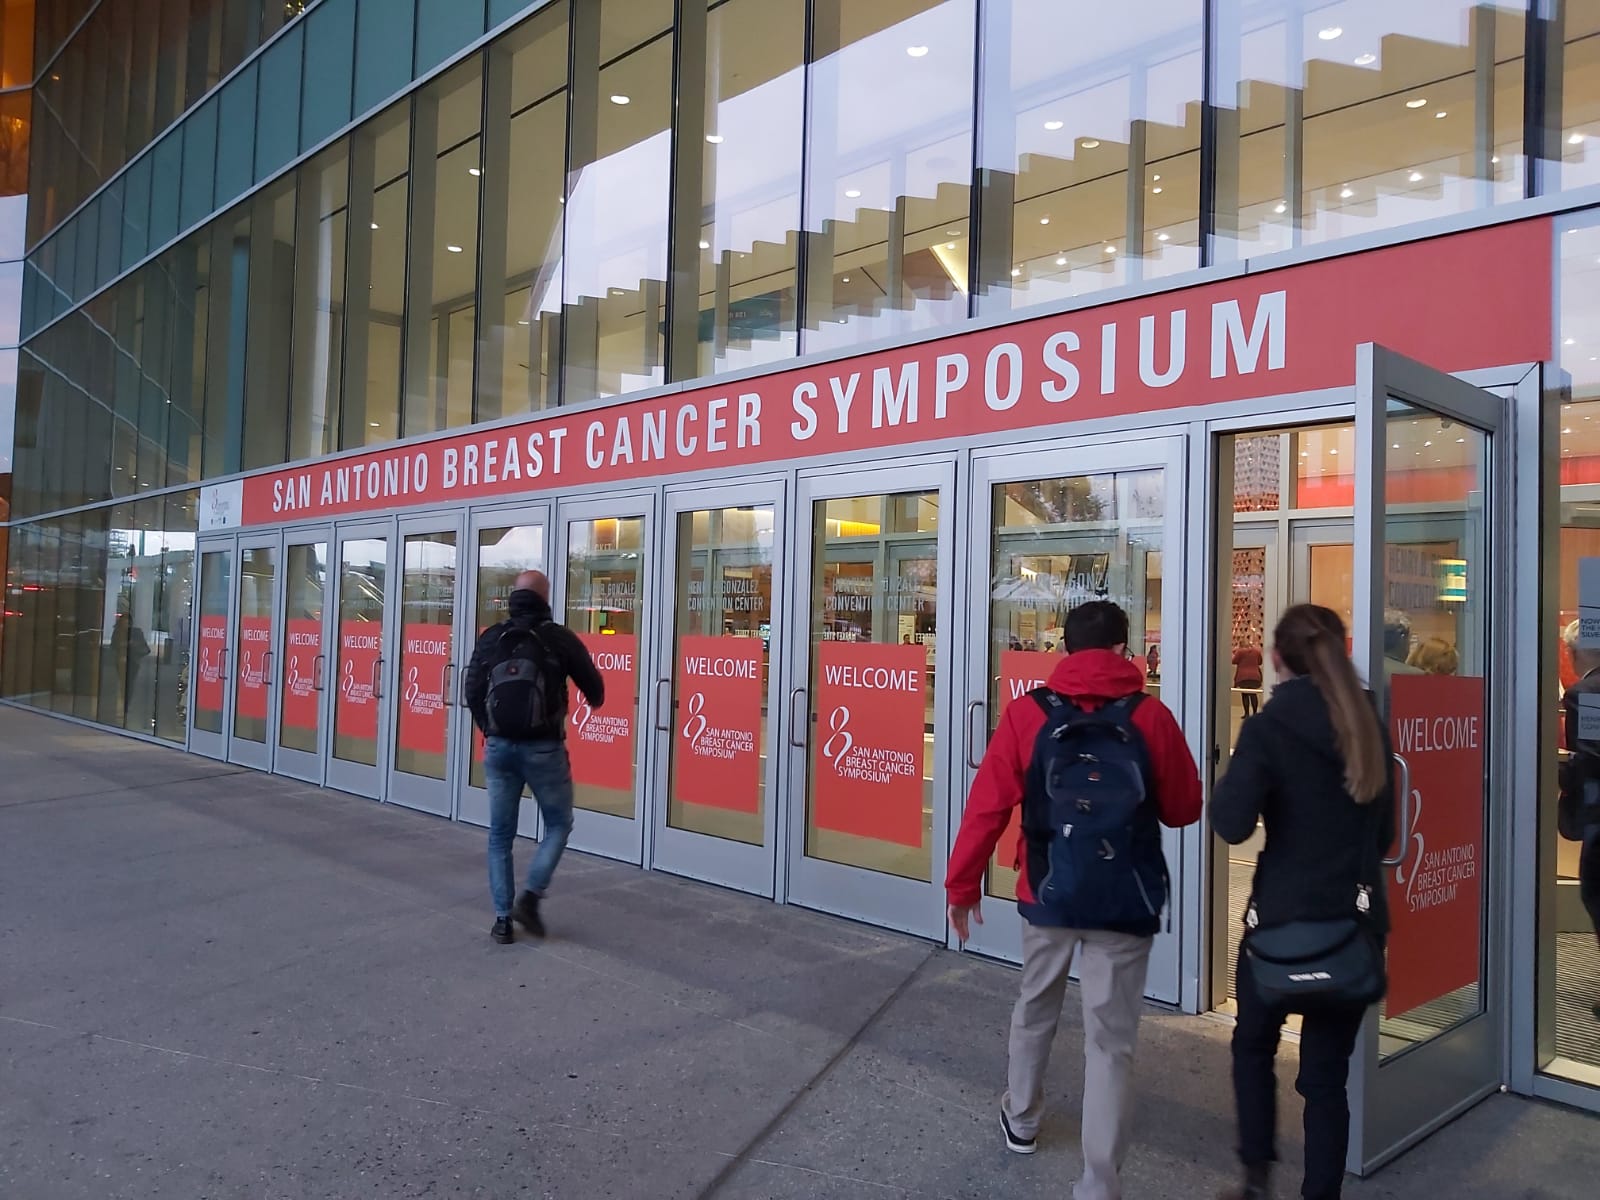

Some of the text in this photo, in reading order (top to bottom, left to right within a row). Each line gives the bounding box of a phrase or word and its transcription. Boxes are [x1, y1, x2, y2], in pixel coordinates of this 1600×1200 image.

[272, 474, 312, 514] SAN
[320, 452, 429, 507] ANTONIO
[443, 427, 569, 490] BREAST
[586, 392, 762, 470] CANCER
[790, 290, 1287, 441] SYMPOSIUM
[734, 596, 764, 612] CENTER
[825, 595, 884, 612] CONVENTI
[202, 627, 225, 639] WELCOME
[243, 629, 269, 642] WELCOME
[290, 632, 319, 646] WELCOME
[344, 636, 378, 650] WELCOME
[407, 640, 447, 656] WELCOME
[685, 656, 757, 679] WELCOME
[825, 664, 919, 692] WELCOME
[591, 715, 628, 728] SAN ANTONIO
[586, 724, 629, 737] BREAST CANCER
[706, 727, 753, 742] SAN ANTONIO
[1397, 716, 1478, 753] WELCOME
[694, 745, 735, 760] SYMPOSIUM
[700, 736, 754, 753] BREAST CANCER
[853, 745, 914, 765] SAN ANTONIO
[846, 756, 915, 777] BREAST CANCER
[838, 766, 891, 785] SYMPOSIUM
[1424, 844, 1475, 871] SAN ANTONIO
[1417, 861, 1475, 891] BREAST CANCER
[1409, 883, 1457, 913] SYMPOSIUM
